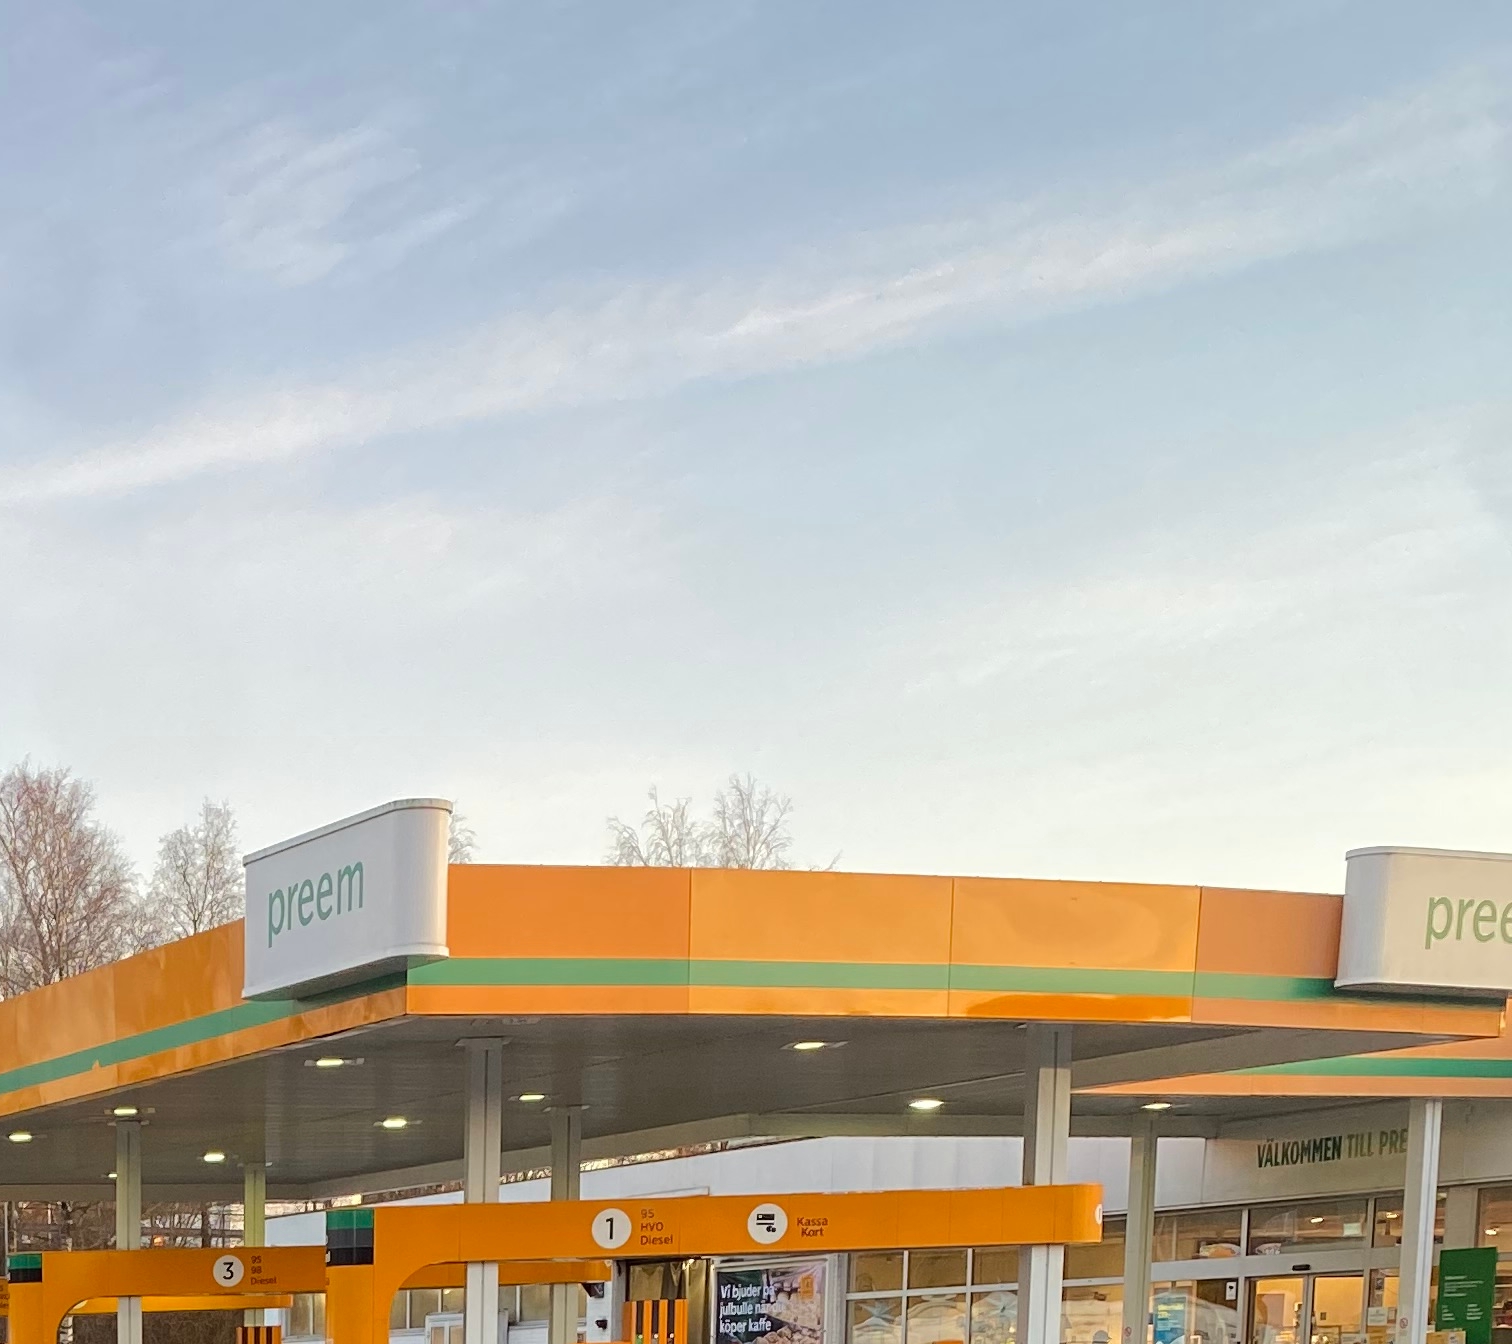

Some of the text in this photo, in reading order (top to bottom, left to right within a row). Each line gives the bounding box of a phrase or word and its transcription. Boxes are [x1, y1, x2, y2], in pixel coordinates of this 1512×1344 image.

[267, 860, 364, 949] preem
[1256, 1136, 1343, 1169] VÄLKOMMEN
[1346, 1131, 1374, 1159] TILL
[605, 1217, 614, 1240] 1
[640, 1221, 664, 1232] HVO
[796, 1217, 829, 1227] Kassa
[640, 1234, 674, 1246] Diesel
[801, 1227, 825, 1238] Kort
[222, 1261, 234, 1280] 3
[720, 1283, 731, 1299] Vi
[731, 1283, 762, 1301] bjuder
[719, 1301, 754, 1319] julbulle
[719, 1316, 772, 1338] köper kaffe
